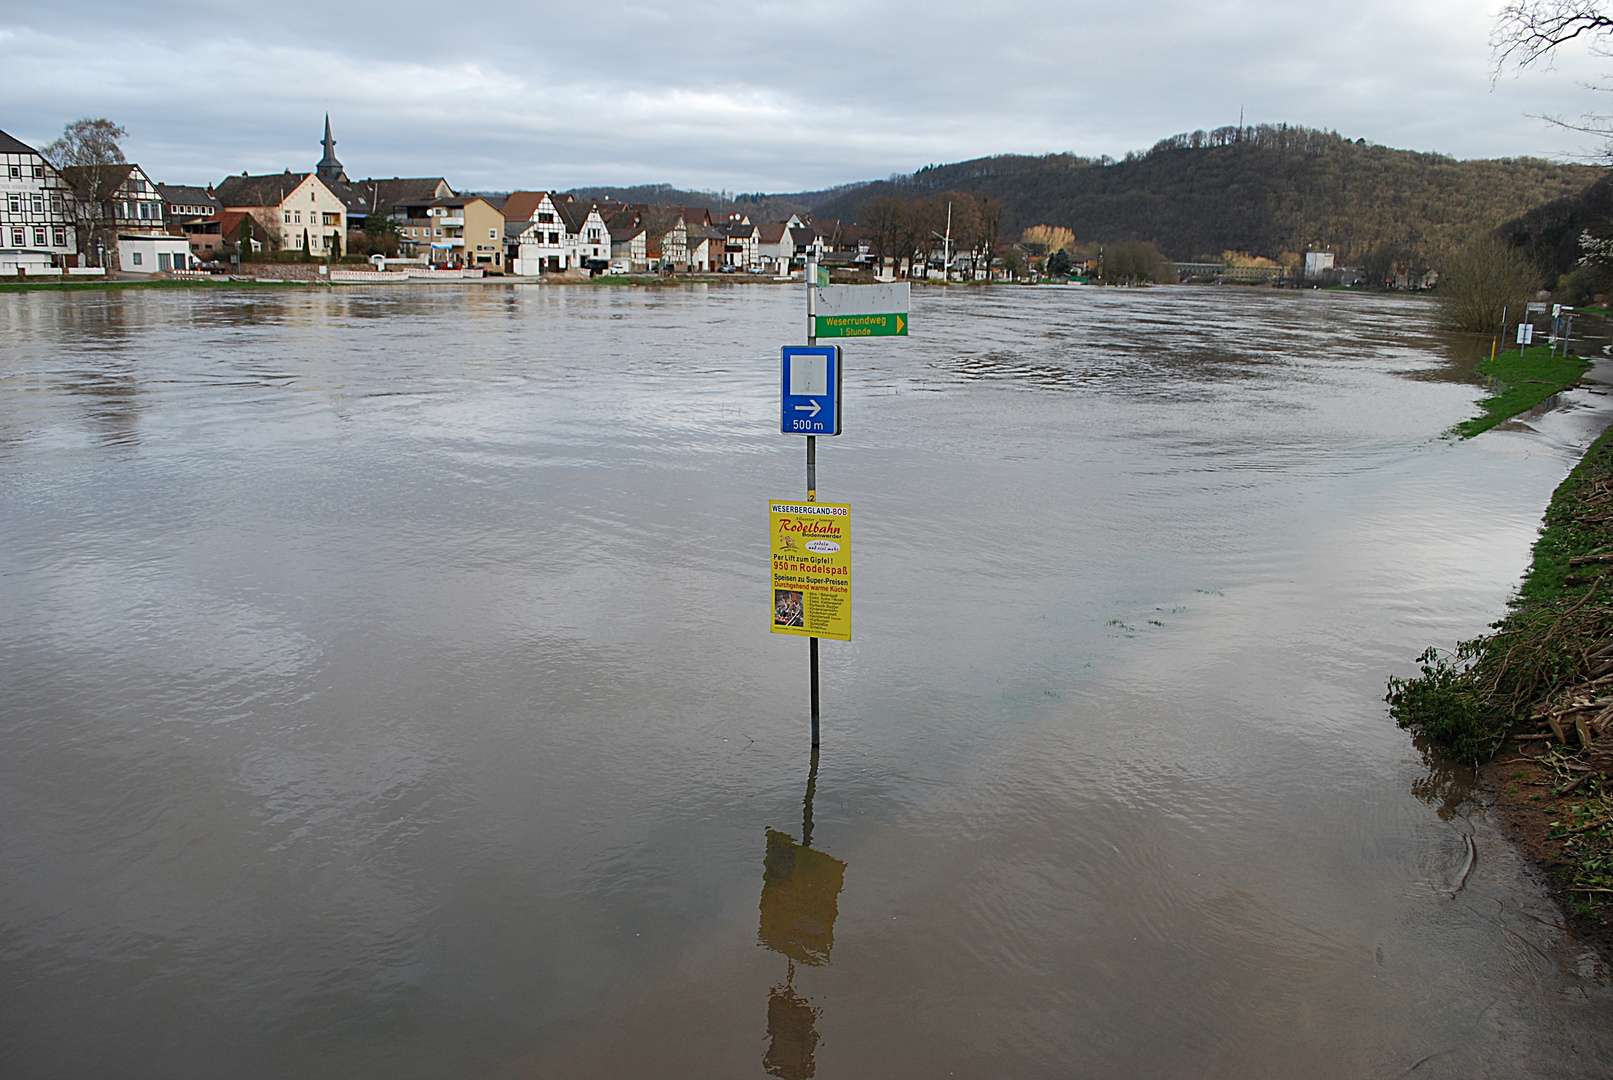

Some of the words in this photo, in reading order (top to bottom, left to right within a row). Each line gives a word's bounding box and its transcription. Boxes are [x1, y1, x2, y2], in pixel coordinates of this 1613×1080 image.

[826, 315, 887, 326] Weserrundweg
[846, 327, 872, 336] Stunde
[793, 419, 811, 430] 500
[814, 421, 824, 430] m
[772, 505, 847, 515] WESERBERGLAND-BOB
[778, 518, 841, 534] Rodelbahn
[810, 556, 830, 565] Gipfel
[773, 561, 789, 571] 950
[799, 563, 848, 576] Rodelspaß
[774, 573, 796, 582] Speisen
[806, 576, 848, 585] Super-Preisen
[774, 581, 809, 590] Durchgehend
[830, 585, 847, 593] Küche
